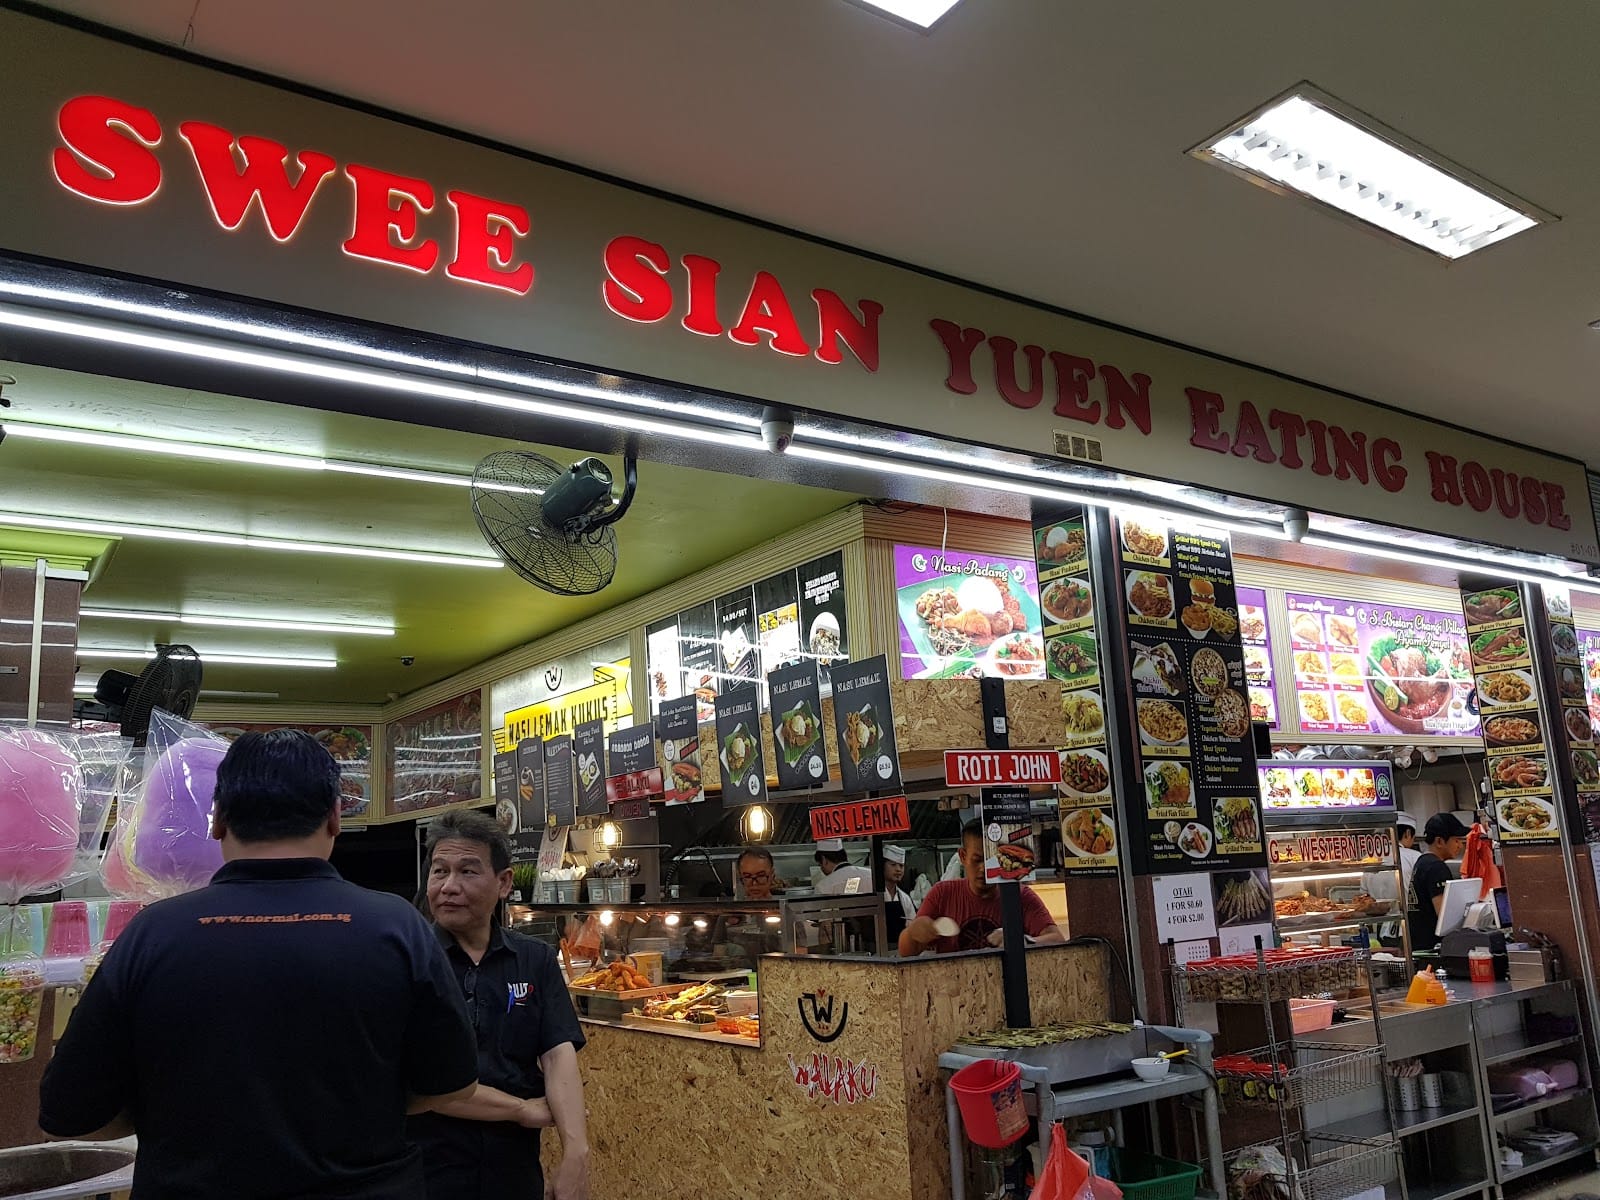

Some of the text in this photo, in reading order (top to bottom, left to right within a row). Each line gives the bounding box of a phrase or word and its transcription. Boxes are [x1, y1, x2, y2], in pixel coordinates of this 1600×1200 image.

[52, 94, 1572, 532] SWEE SIAN YUEN EATING HOUSE
[931, 555, 1008, 581] Nasi Padang
[773, 676, 812, 695] NASI LEMAK
[837, 673, 880, 693] NASI LEMAK
[719, 701, 752, 718] NASI LEMAK
[509, 718, 531, 746] NASI
[534, 707, 567, 738] LEMAK
[571, 697, 608, 729] KUKUS
[957, 754, 1051, 781] ROTI JOHN
[815, 800, 902, 835] NASI LEMAK
[1268, 833, 1390, 863] G WESTERN FOOD
[1172, 886, 1193, 897] OTAH
[1166, 902, 1170, 911] 1
[1171, 901, 1186, 911] FOR
[1167, 916, 1172, 924] 4
[1172, 914, 1188, 924] FOR
